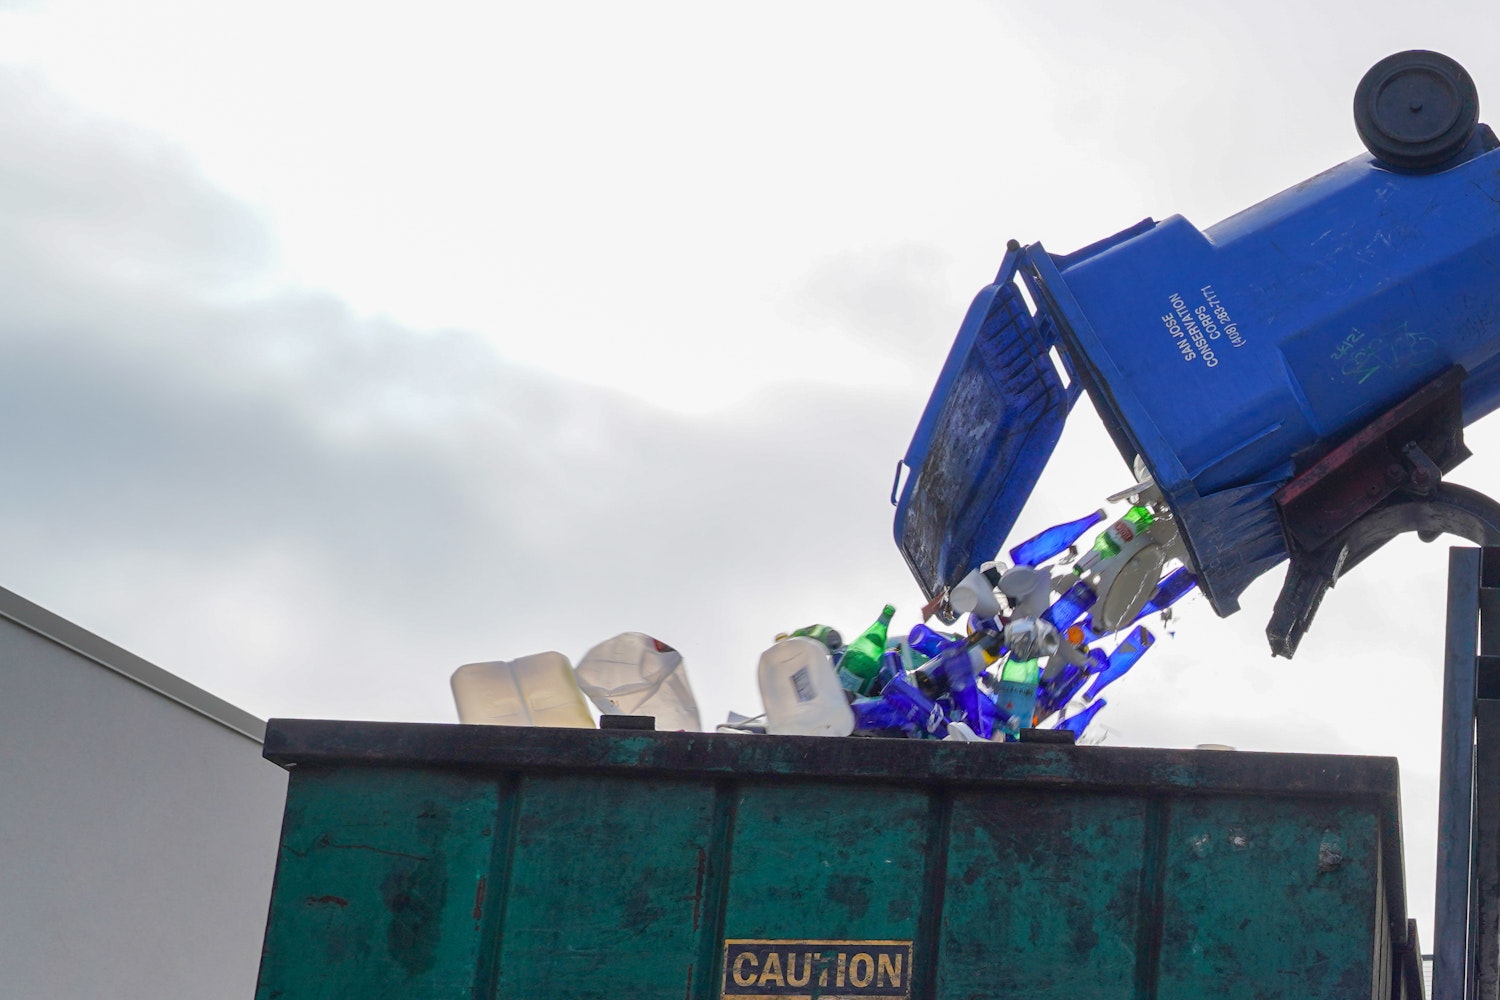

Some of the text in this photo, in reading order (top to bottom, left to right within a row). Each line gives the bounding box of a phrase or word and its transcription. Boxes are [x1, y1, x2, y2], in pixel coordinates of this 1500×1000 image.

[1162, 313, 1196, 361] SAN JOSE
[1169, 293, 1218, 367] CONSERVATION
[1195, 306, 1220, 339] CORPS
[1201, 285, 1246, 347] (408) 283-7171
